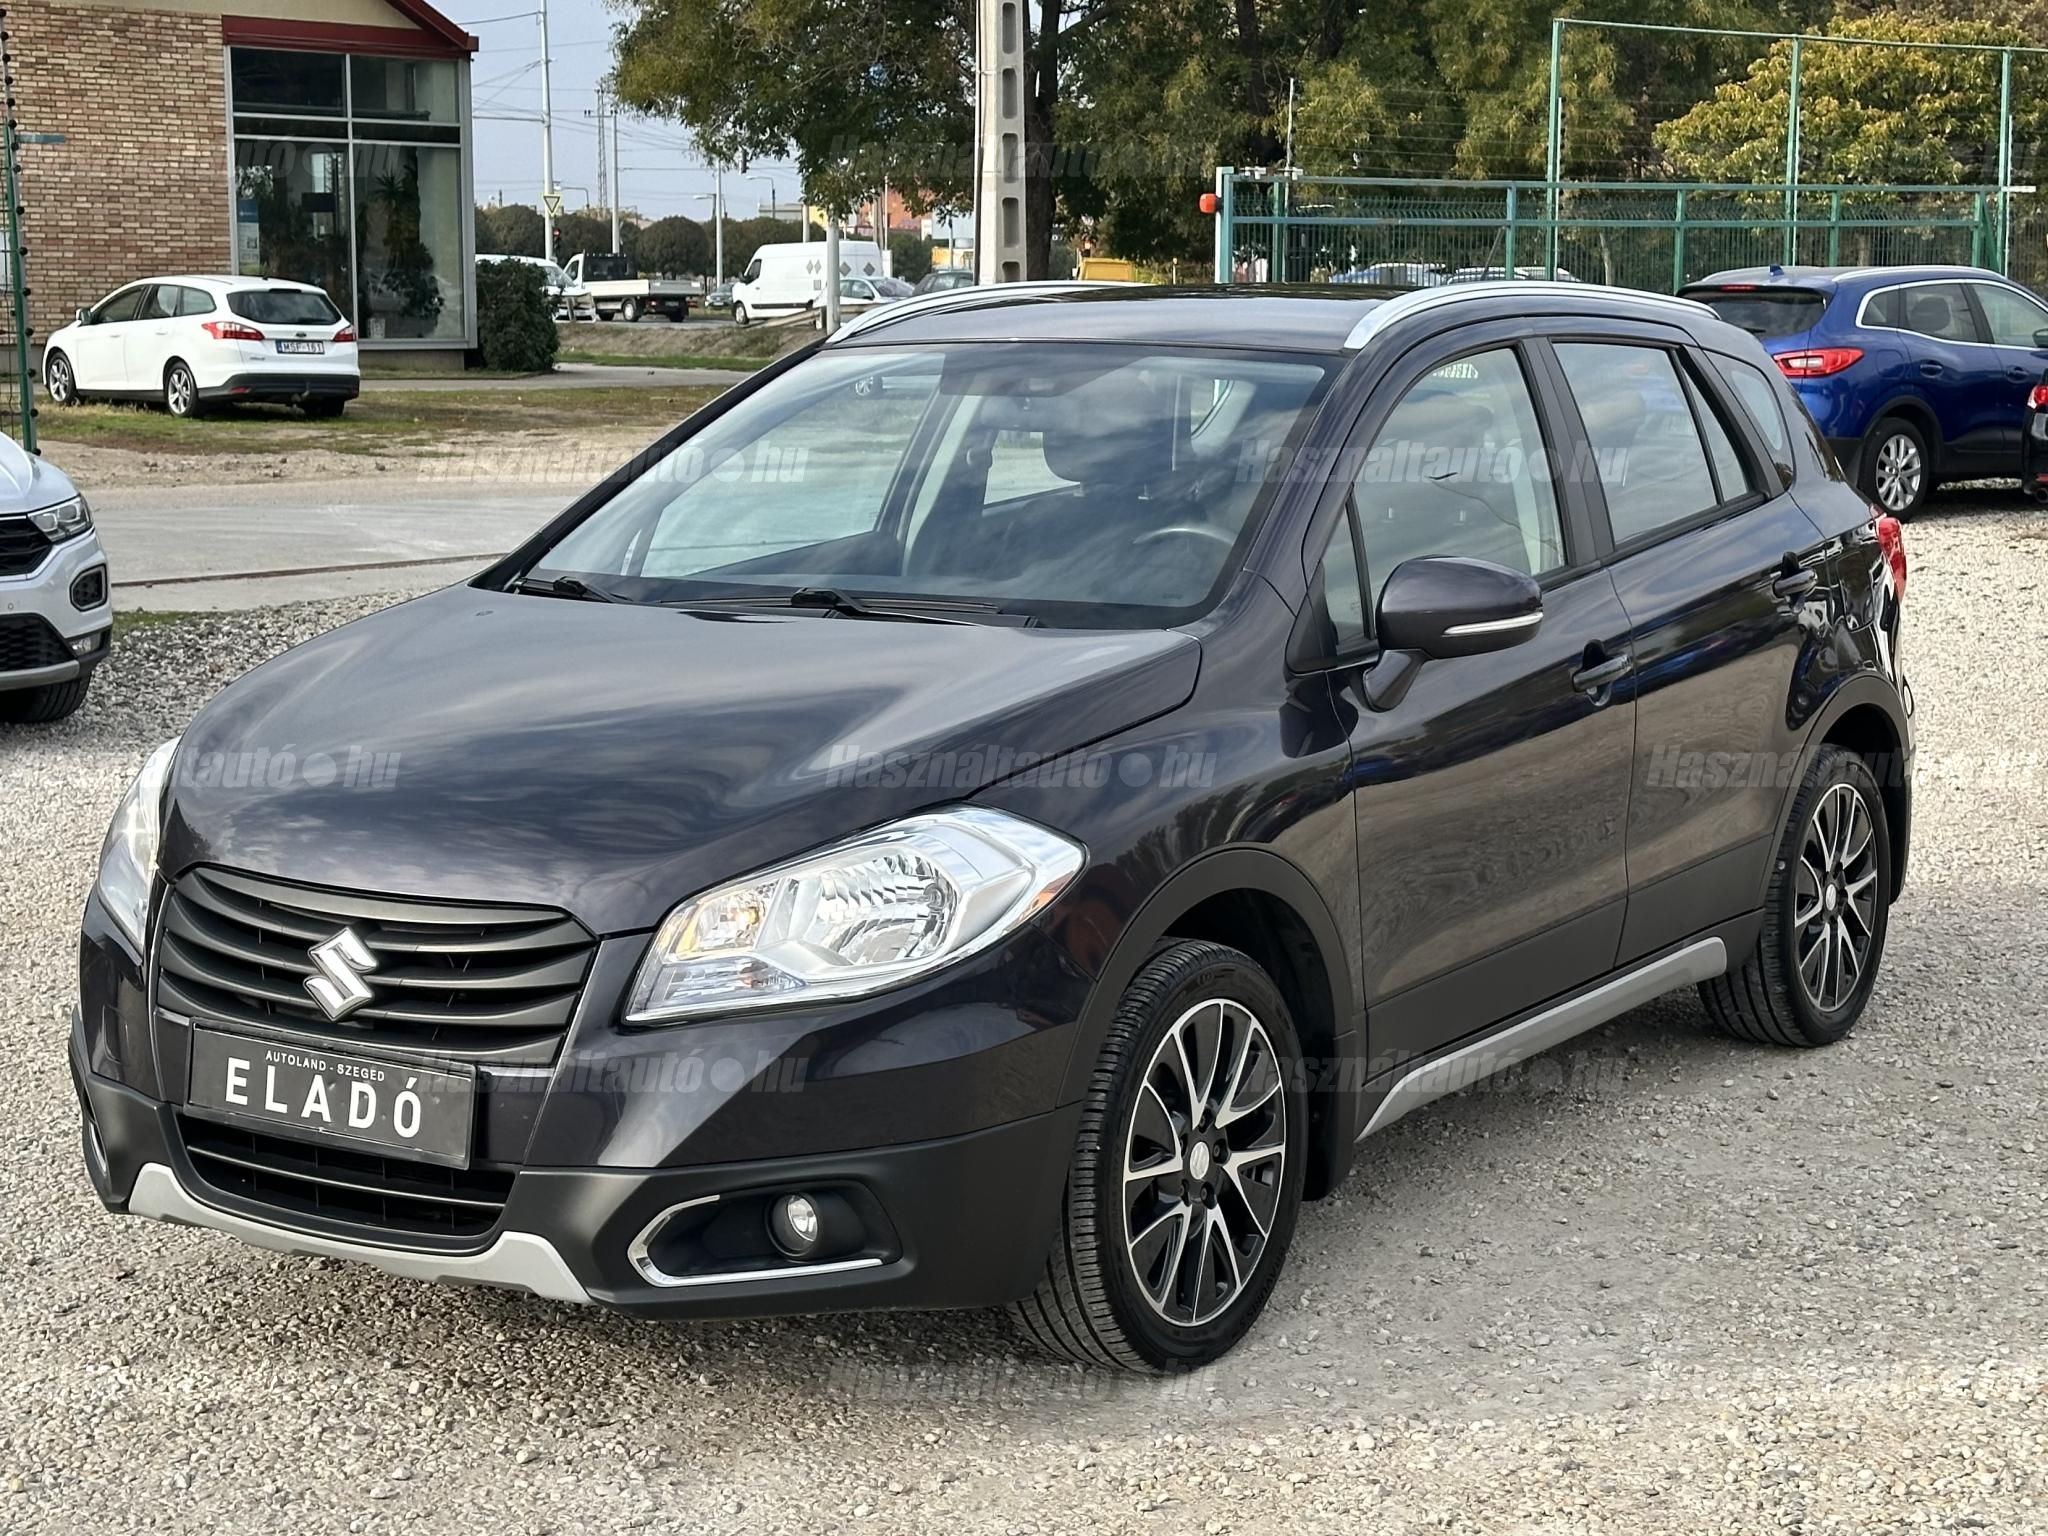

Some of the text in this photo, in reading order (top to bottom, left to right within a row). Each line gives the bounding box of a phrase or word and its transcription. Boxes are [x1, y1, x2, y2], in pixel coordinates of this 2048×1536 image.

[265, 1050, 327, 1072] AUTOLAND
[336, 1063, 386, 1082] SZEGED
[225, 1057, 422, 1138] ELADÓ
